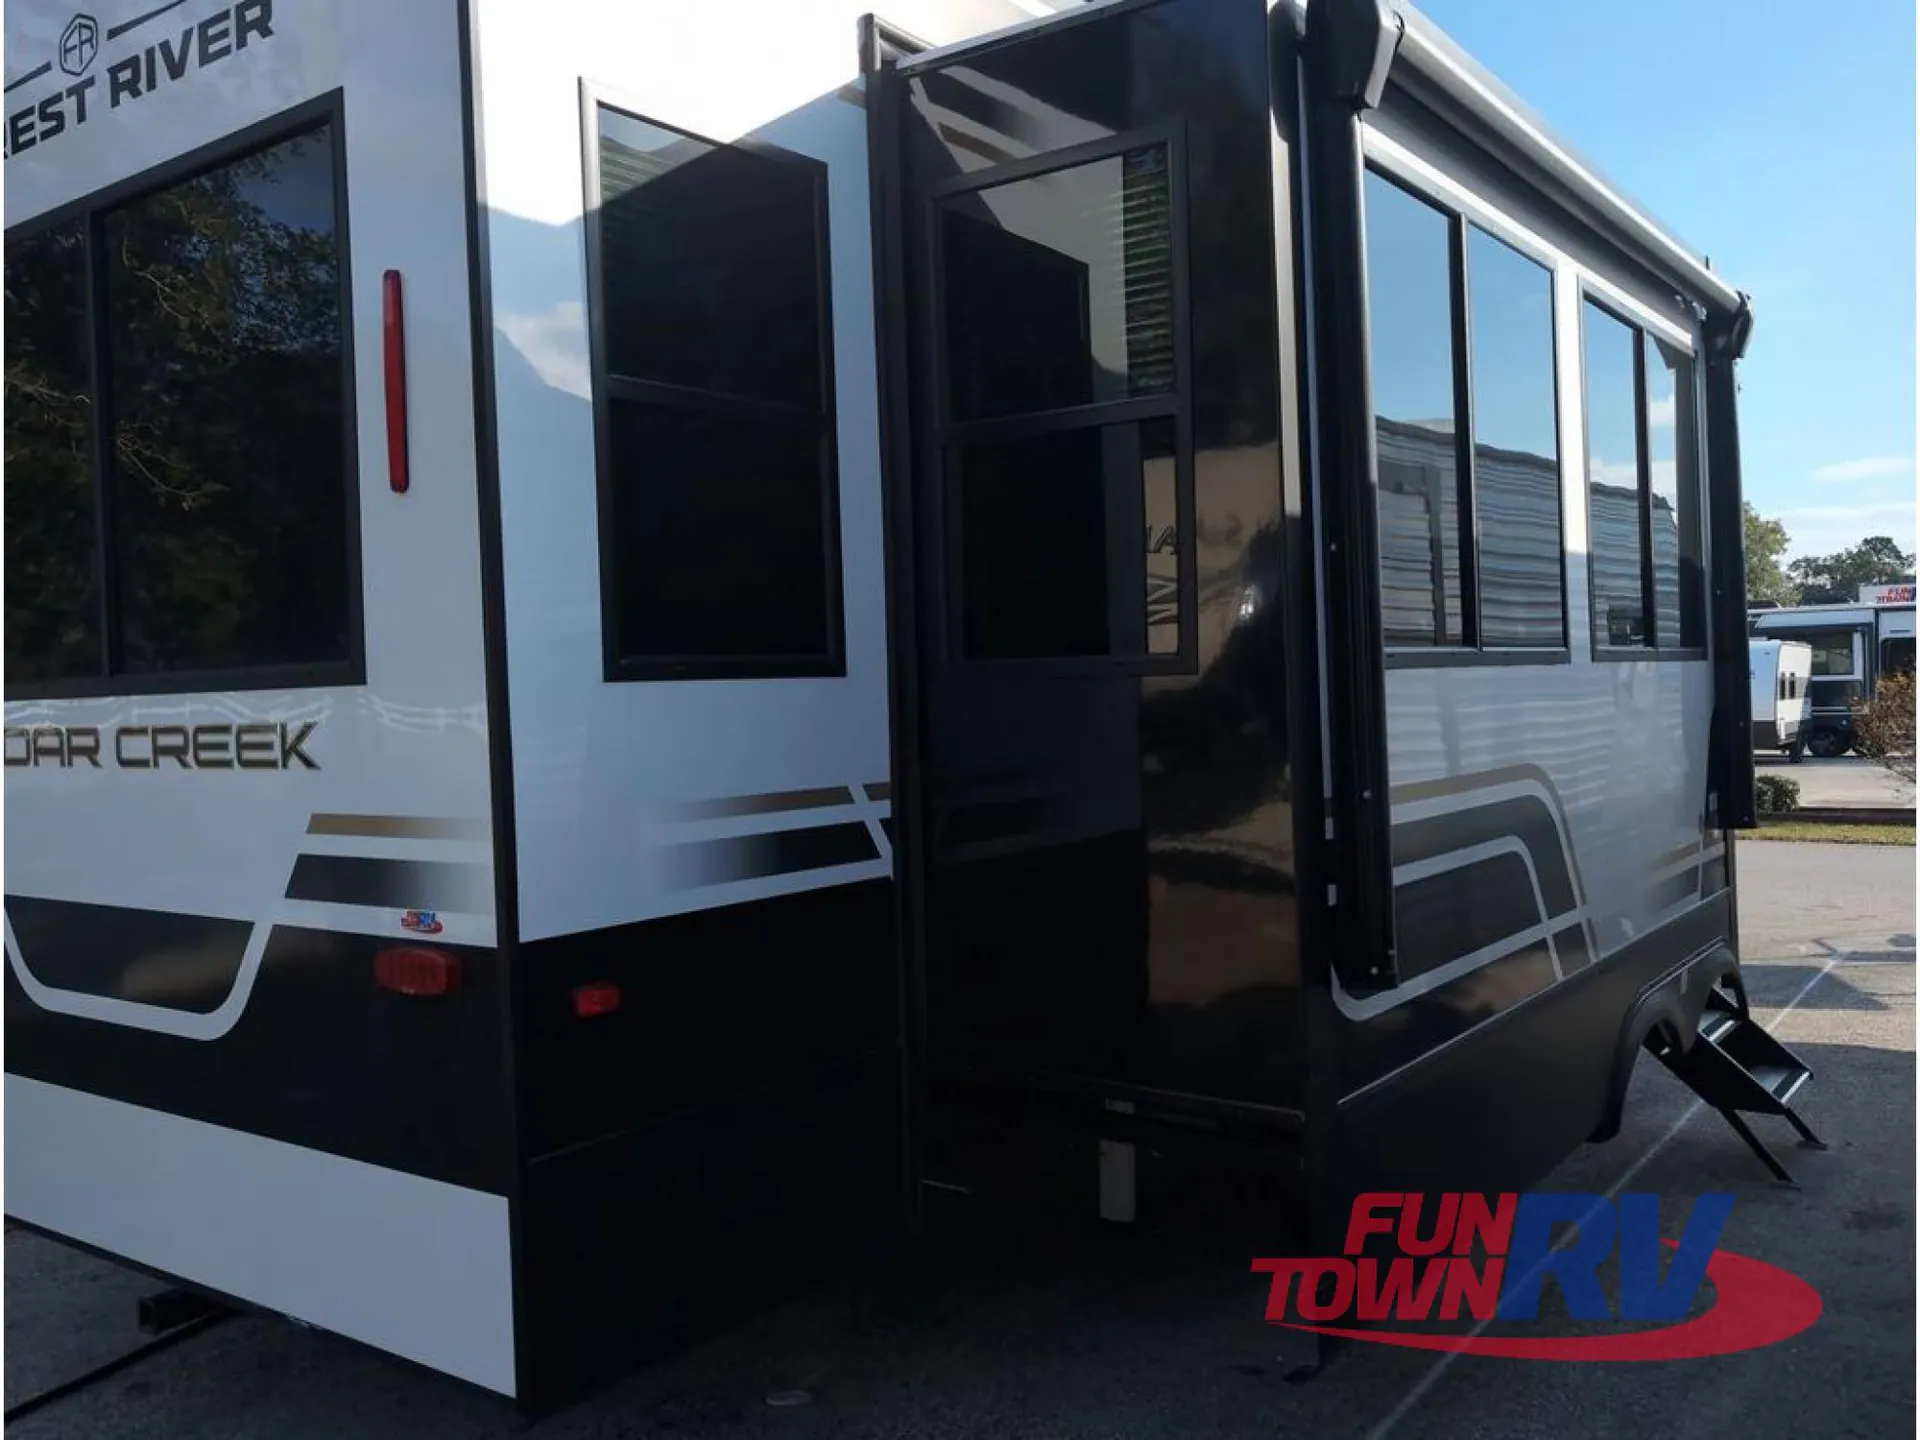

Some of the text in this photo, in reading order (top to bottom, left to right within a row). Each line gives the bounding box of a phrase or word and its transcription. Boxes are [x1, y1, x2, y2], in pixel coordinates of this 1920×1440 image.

[4, 0, 274, 159] EST RIVER
[115, 721, 321, 770] CREEK
